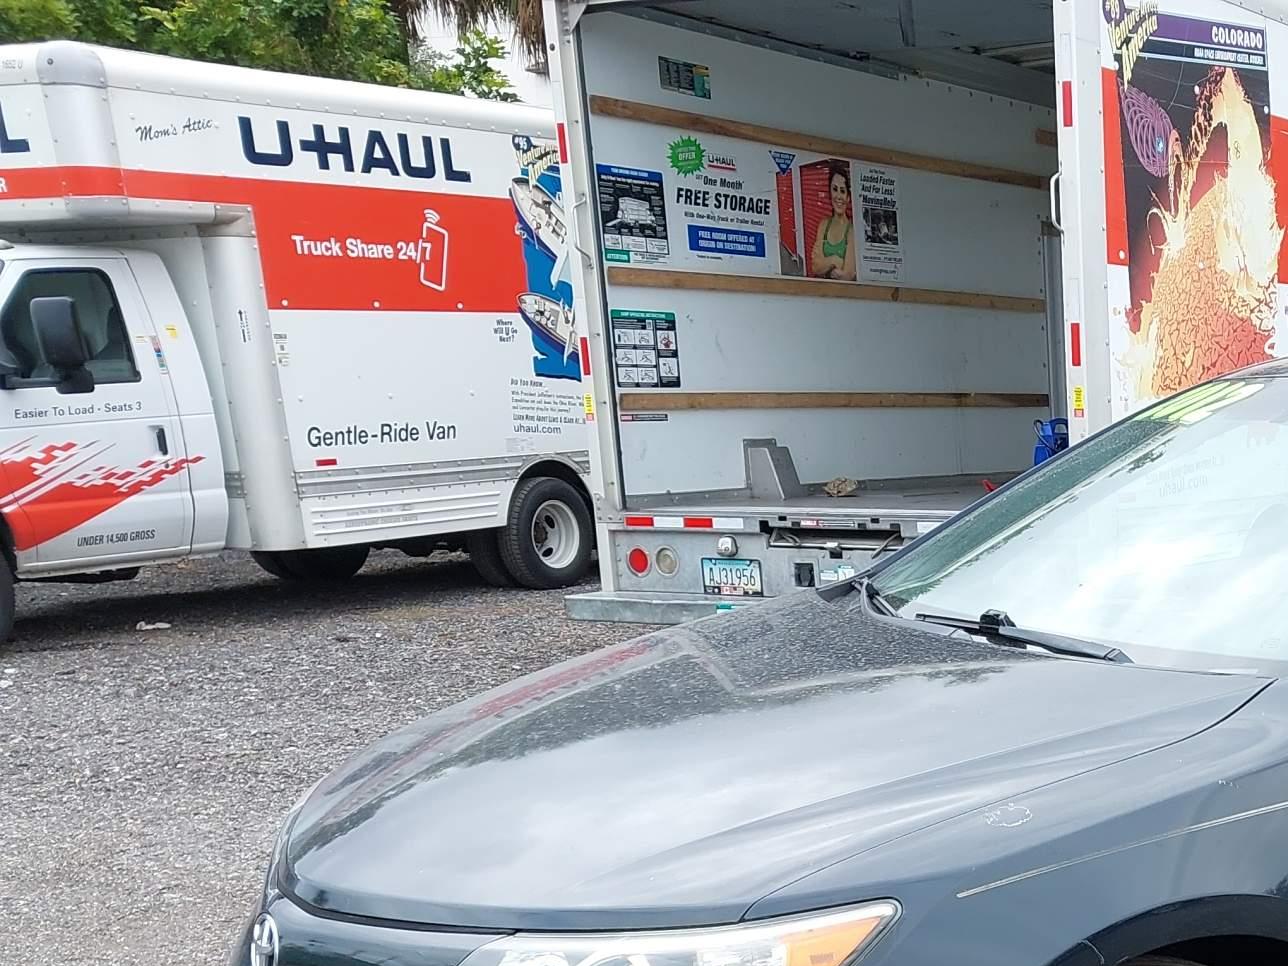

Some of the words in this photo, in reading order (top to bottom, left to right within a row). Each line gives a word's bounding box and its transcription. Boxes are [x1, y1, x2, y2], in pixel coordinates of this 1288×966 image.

[1108, 10, 1140, 51] Venture
[1211, 25, 1263, 48] COLORADO
[1122, 14, 1158, 92] America
[136, 123, 178, 141] Mom's
[238, 116, 472, 183] U-HAUL
[514, 144, 546, 170] Venture
[678, 151, 696, 161] OFFER
[708, 154, 736, 167] U-HAUL
[703, 175, 718, 187] One
[860, 174, 879, 184] Loaded
[879, 177, 895, 186] Faster
[861, 184, 871, 193] And
[872, 186, 880, 194] For
[881, 187, 895, 196] Less!
[676, 187, 709, 207] FREE
[714, 192, 771, 215] STORAGE
[696, 212, 716, 222] One-Way
[717, 215, 729, 223] Truck
[736, 217, 749, 225] Trailer
[291, 234, 343, 257] Truck
[347, 238, 394, 259] Share
[396, 239, 432, 263] 24/7
[510, 378, 519, 386] DID
[520, 379, 529, 387] YOU
[14, 408, 49, 420] Easier
[52, 406, 65, 417] To
[68, 405, 95, 416] Load
[104, 402, 134, 413] Seats
[135, 401, 142, 411] 3
[307, 422, 419, 447] Gentle-Ride
[427, 421, 457, 441] Van
[514, 424, 562, 434] uhaul.com
[77, 535, 104, 547] UNDER
[106, 532, 129, 545] 14,500
[130, 529, 156, 542] GROSS
[708, 567, 757, 587] AJ31956
